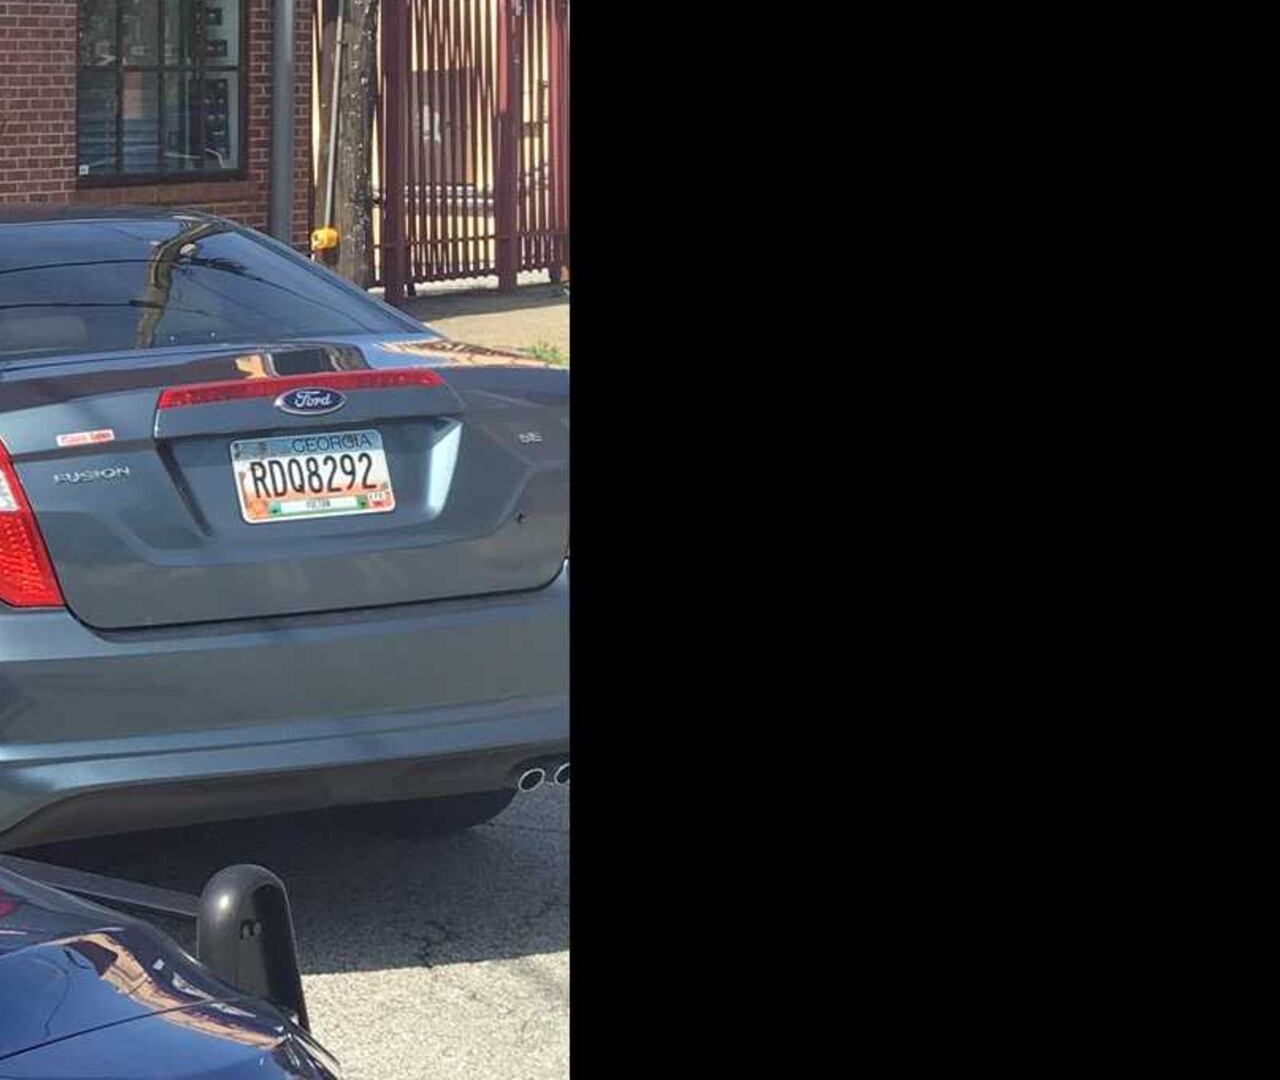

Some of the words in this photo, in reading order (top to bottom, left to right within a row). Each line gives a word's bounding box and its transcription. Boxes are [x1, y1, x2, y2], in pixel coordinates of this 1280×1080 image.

[293, 390, 333, 408] Ford
[291, 433, 373, 454] GEORGIA
[53, 466, 130, 483] FUSION
[249, 452, 378, 499] RDQ8292
